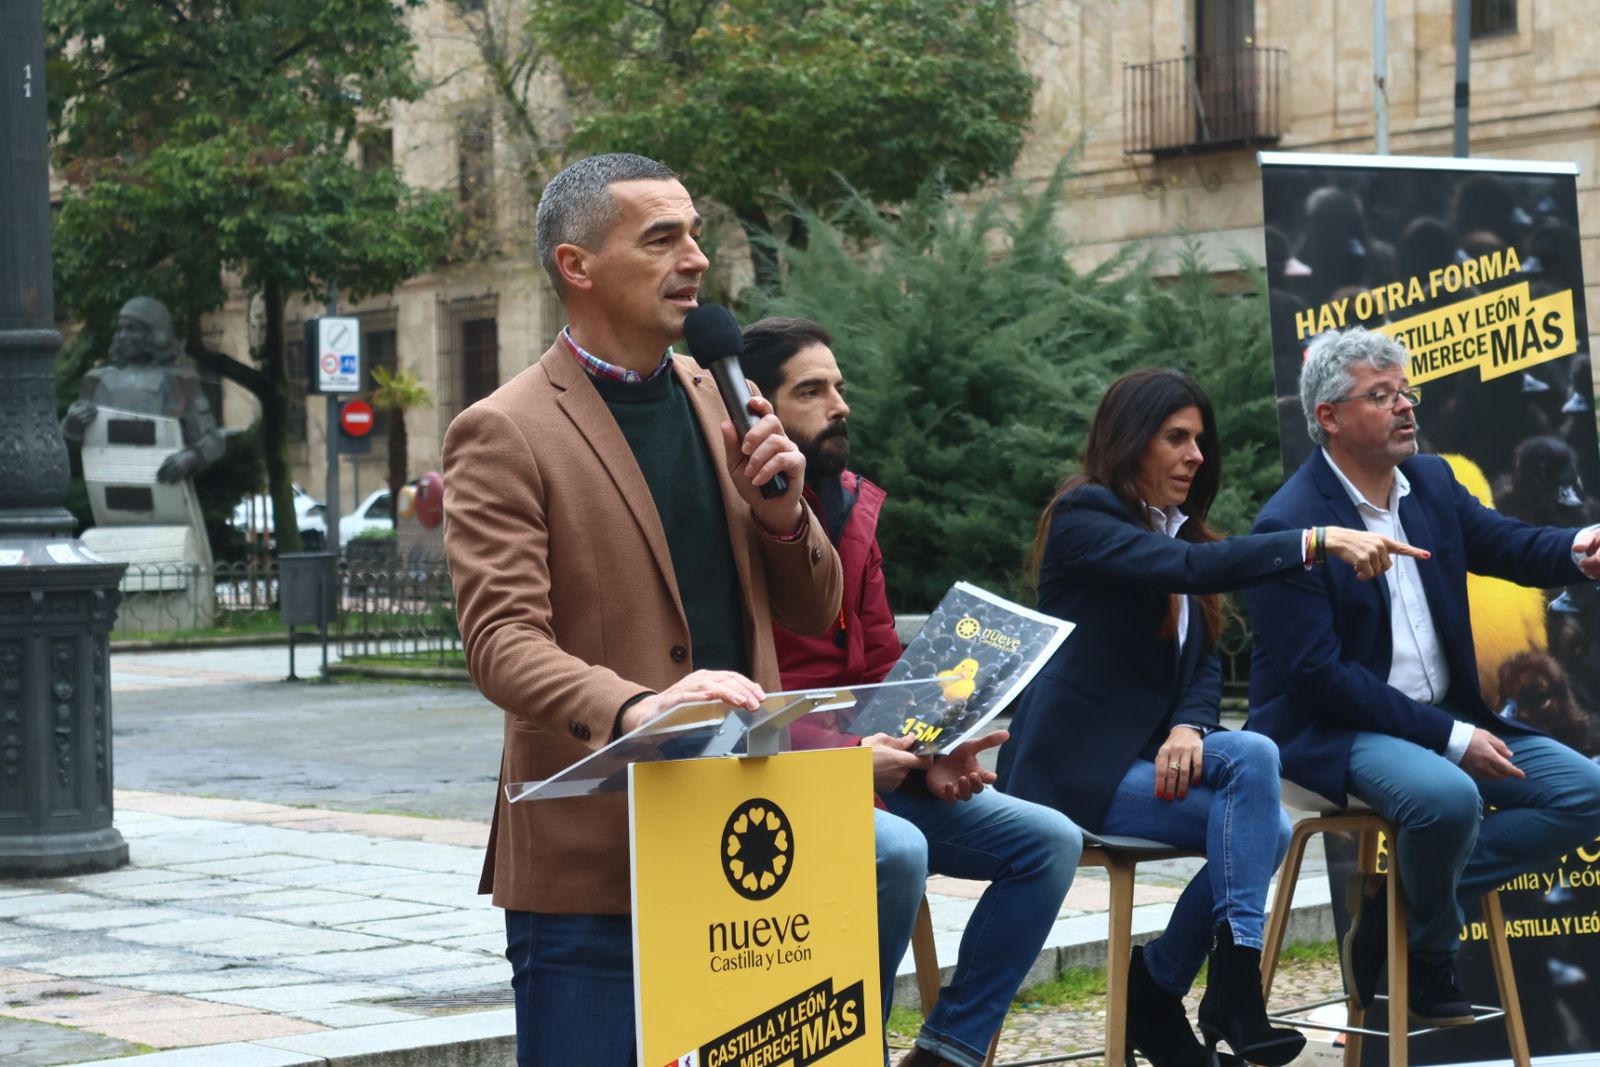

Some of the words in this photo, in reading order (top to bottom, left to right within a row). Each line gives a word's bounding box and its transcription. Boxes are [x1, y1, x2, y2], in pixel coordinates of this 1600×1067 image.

[1295, 298, 1349, 340] HAY
[1355, 276, 1425, 321] OTRA
[1429, 246, 1522, 298] FORMA
[1394, 317, 1455, 350] STILLA
[1457, 311, 1470, 334] Y
[1475, 294, 1521, 330] LEÓN
[1411, 333, 1488, 377] MERECE
[1490, 306, 1564, 368] MÁS
[901, 717, 944, 743] 15M
[1542, 872, 1555, 895] y
[709, 913, 810, 953] nueve
[1504, 917, 1562, 939] ASTILLA
[1561, 917, 1572, 935] Y
[1574, 910, 1600, 934] LEÓ
[710, 949, 763, 973] Castilla
[765, 952, 774, 971] y
[777, 944, 812, 965] León
[708, 1019, 776, 1067] CASTILLA
[777, 1011, 788, 1033] Y
[790, 989, 826, 1027] LEÓN
[801, 998, 859, 1060] MÁS
